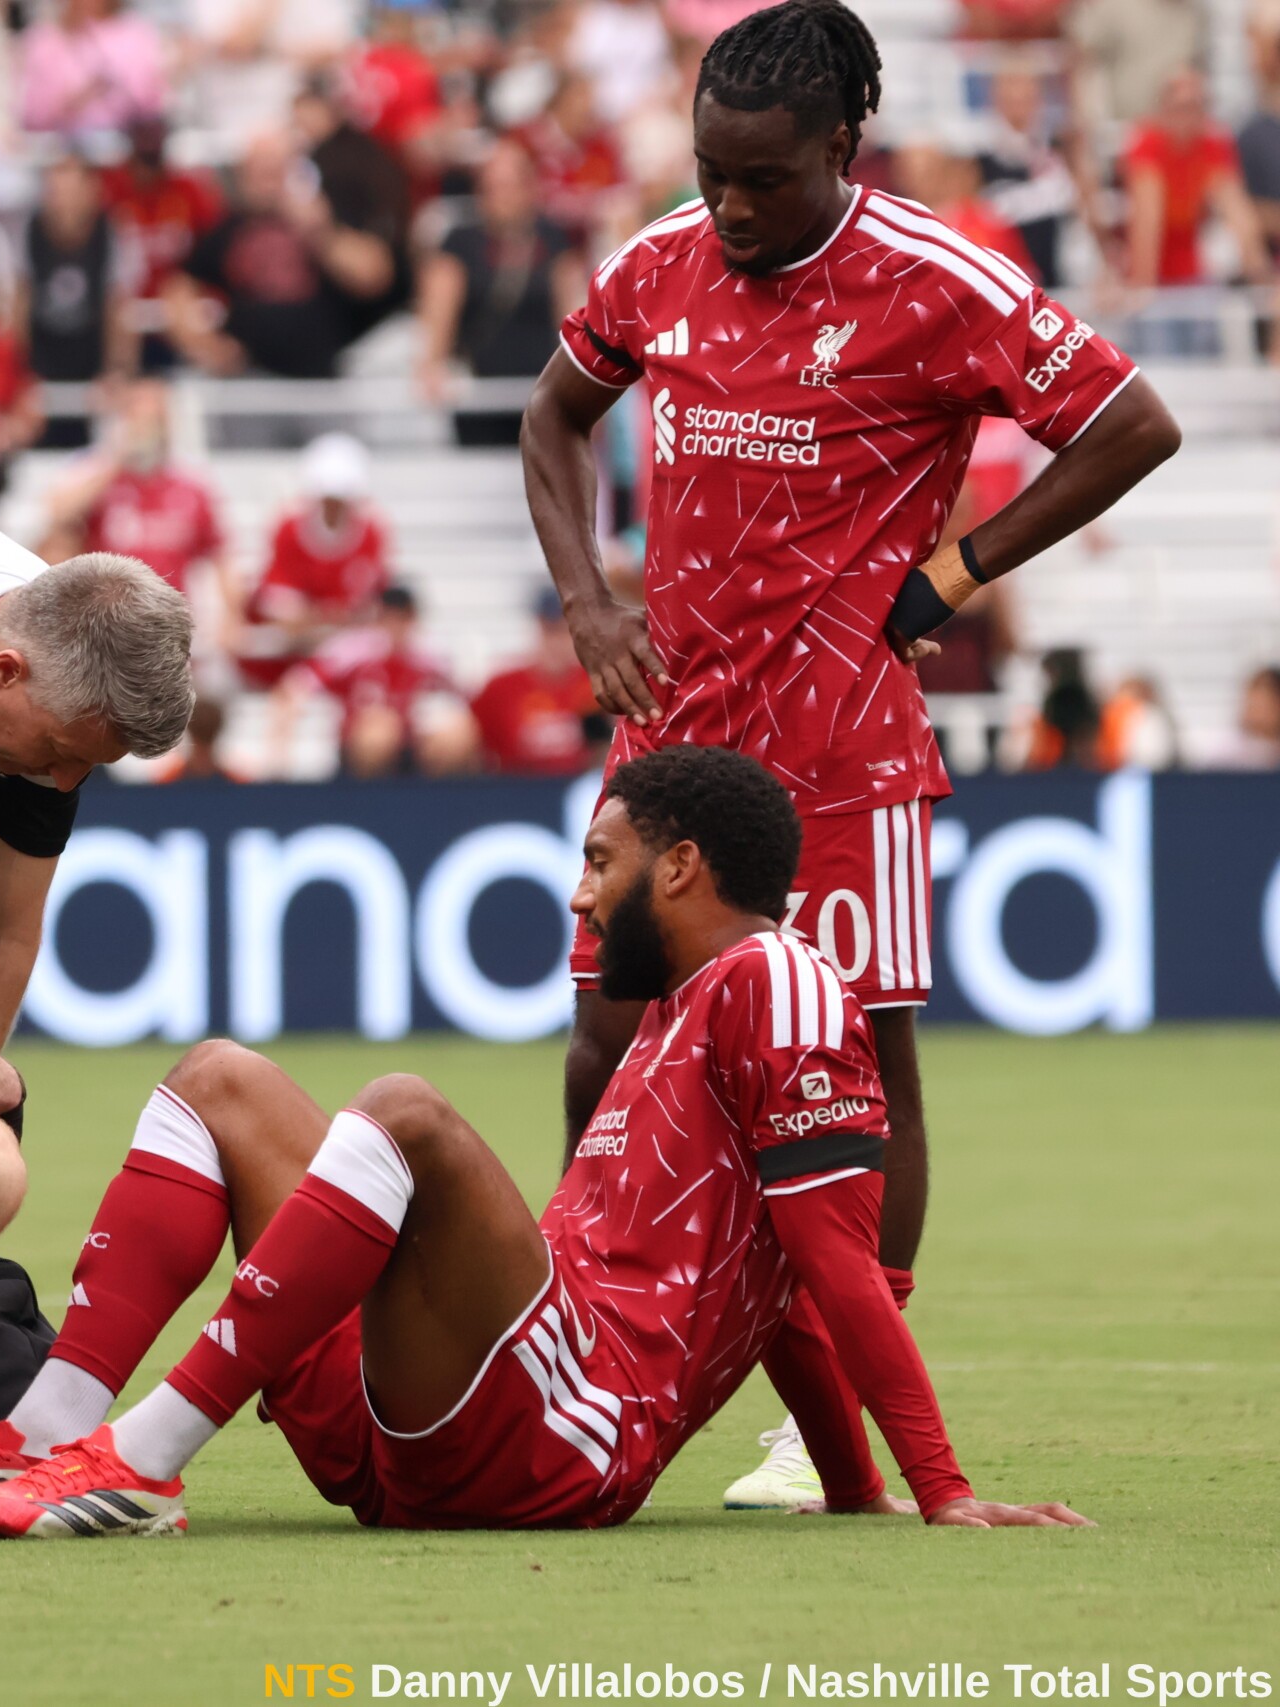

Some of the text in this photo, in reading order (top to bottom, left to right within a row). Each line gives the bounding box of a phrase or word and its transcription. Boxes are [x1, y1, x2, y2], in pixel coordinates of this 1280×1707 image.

[684, 403, 816, 442] standard
[682, 429, 820, 466] chartered
[769, 1096, 870, 1137] Expedia
